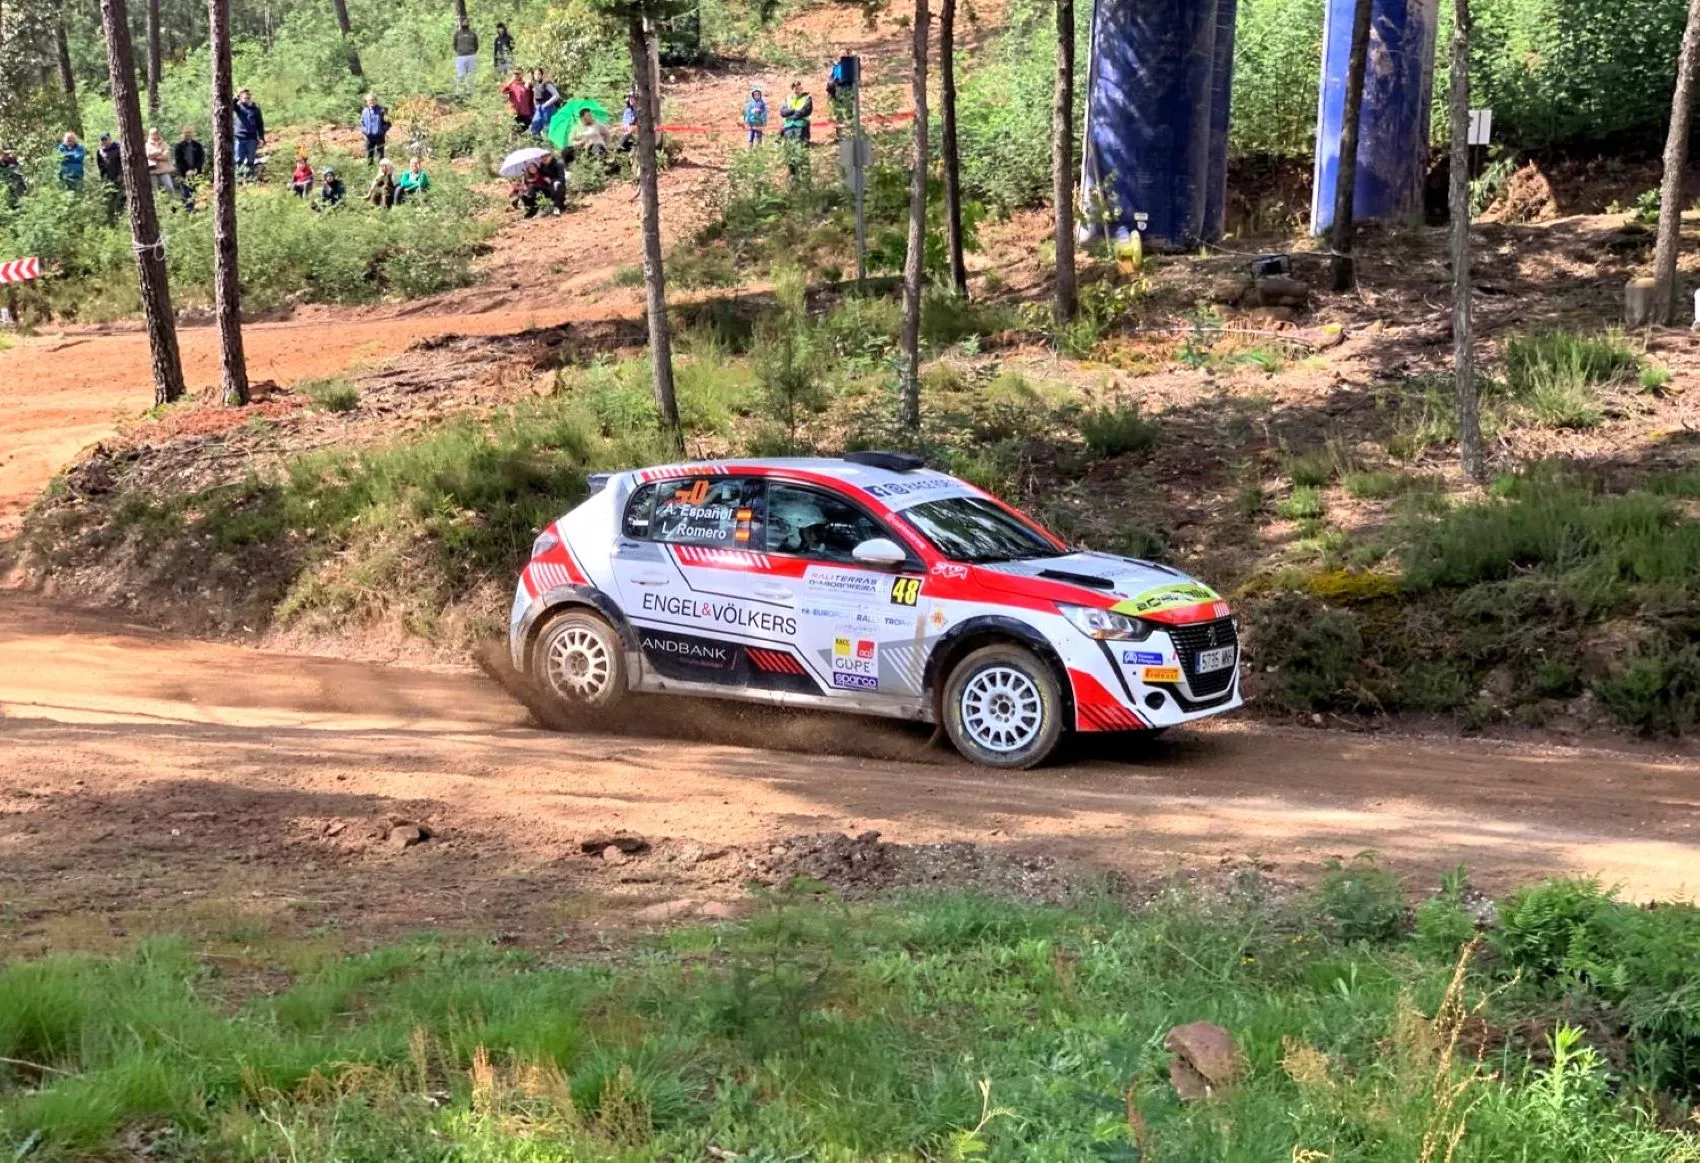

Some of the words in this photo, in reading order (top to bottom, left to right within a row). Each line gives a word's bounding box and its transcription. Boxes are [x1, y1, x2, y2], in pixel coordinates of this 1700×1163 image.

[664, 504, 676, 515] A.
[681, 504, 733, 520] Español
[677, 523, 727, 540] Romero
[835, 574, 878, 585] TERRAS
[893, 579, 919, 605] 48
[642, 637, 727, 661] ANDBANK
